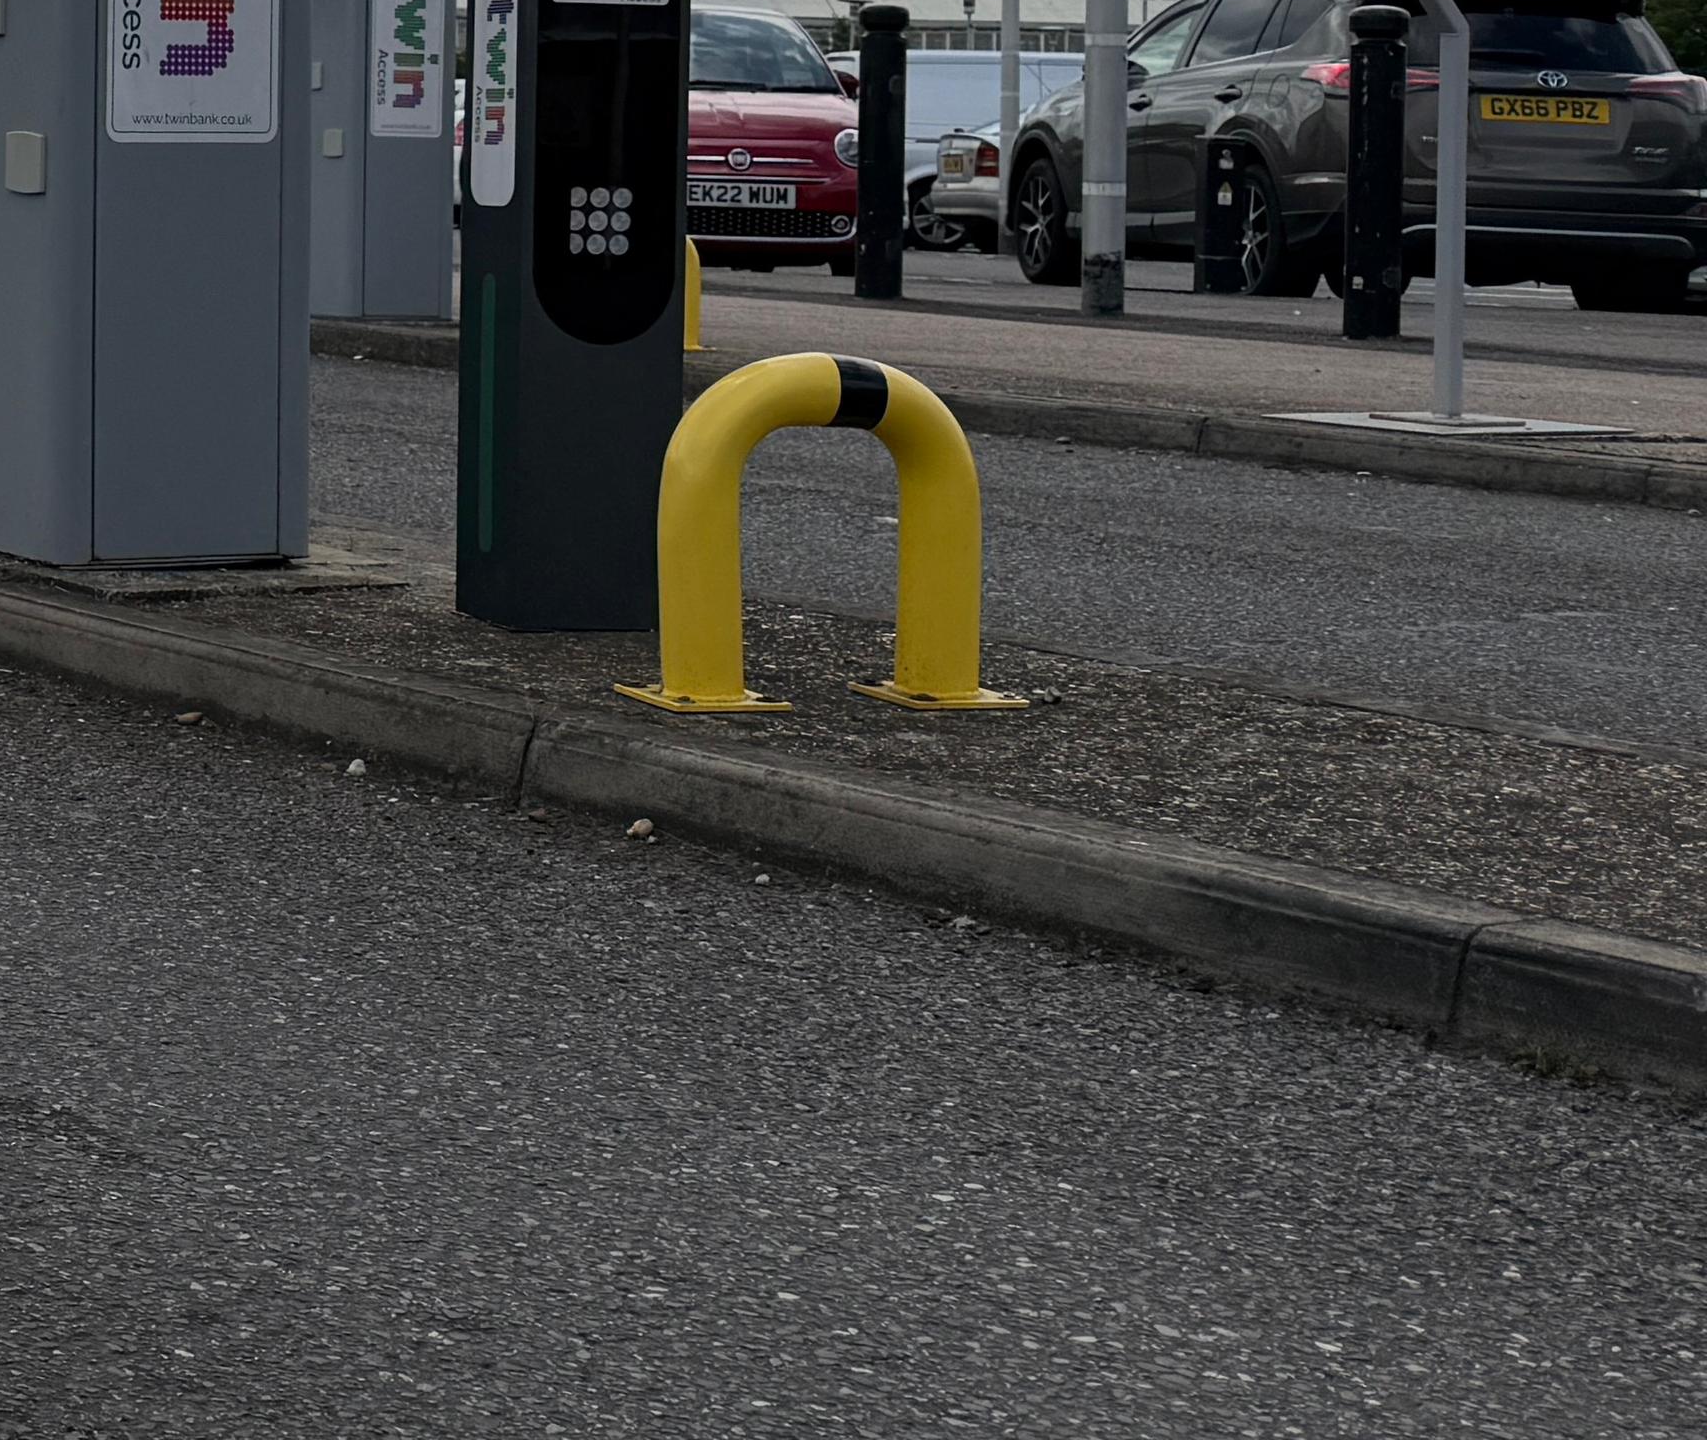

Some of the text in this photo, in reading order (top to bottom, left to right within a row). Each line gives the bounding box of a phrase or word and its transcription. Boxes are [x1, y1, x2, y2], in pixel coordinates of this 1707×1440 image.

[377, 49, 389, 106] Access
[132, 113, 253, 126] www.twinbank.co.uk
[1490, 97, 1600, 120] GX66 PBZ
[688, 184, 789, 205] EK22 WUM
